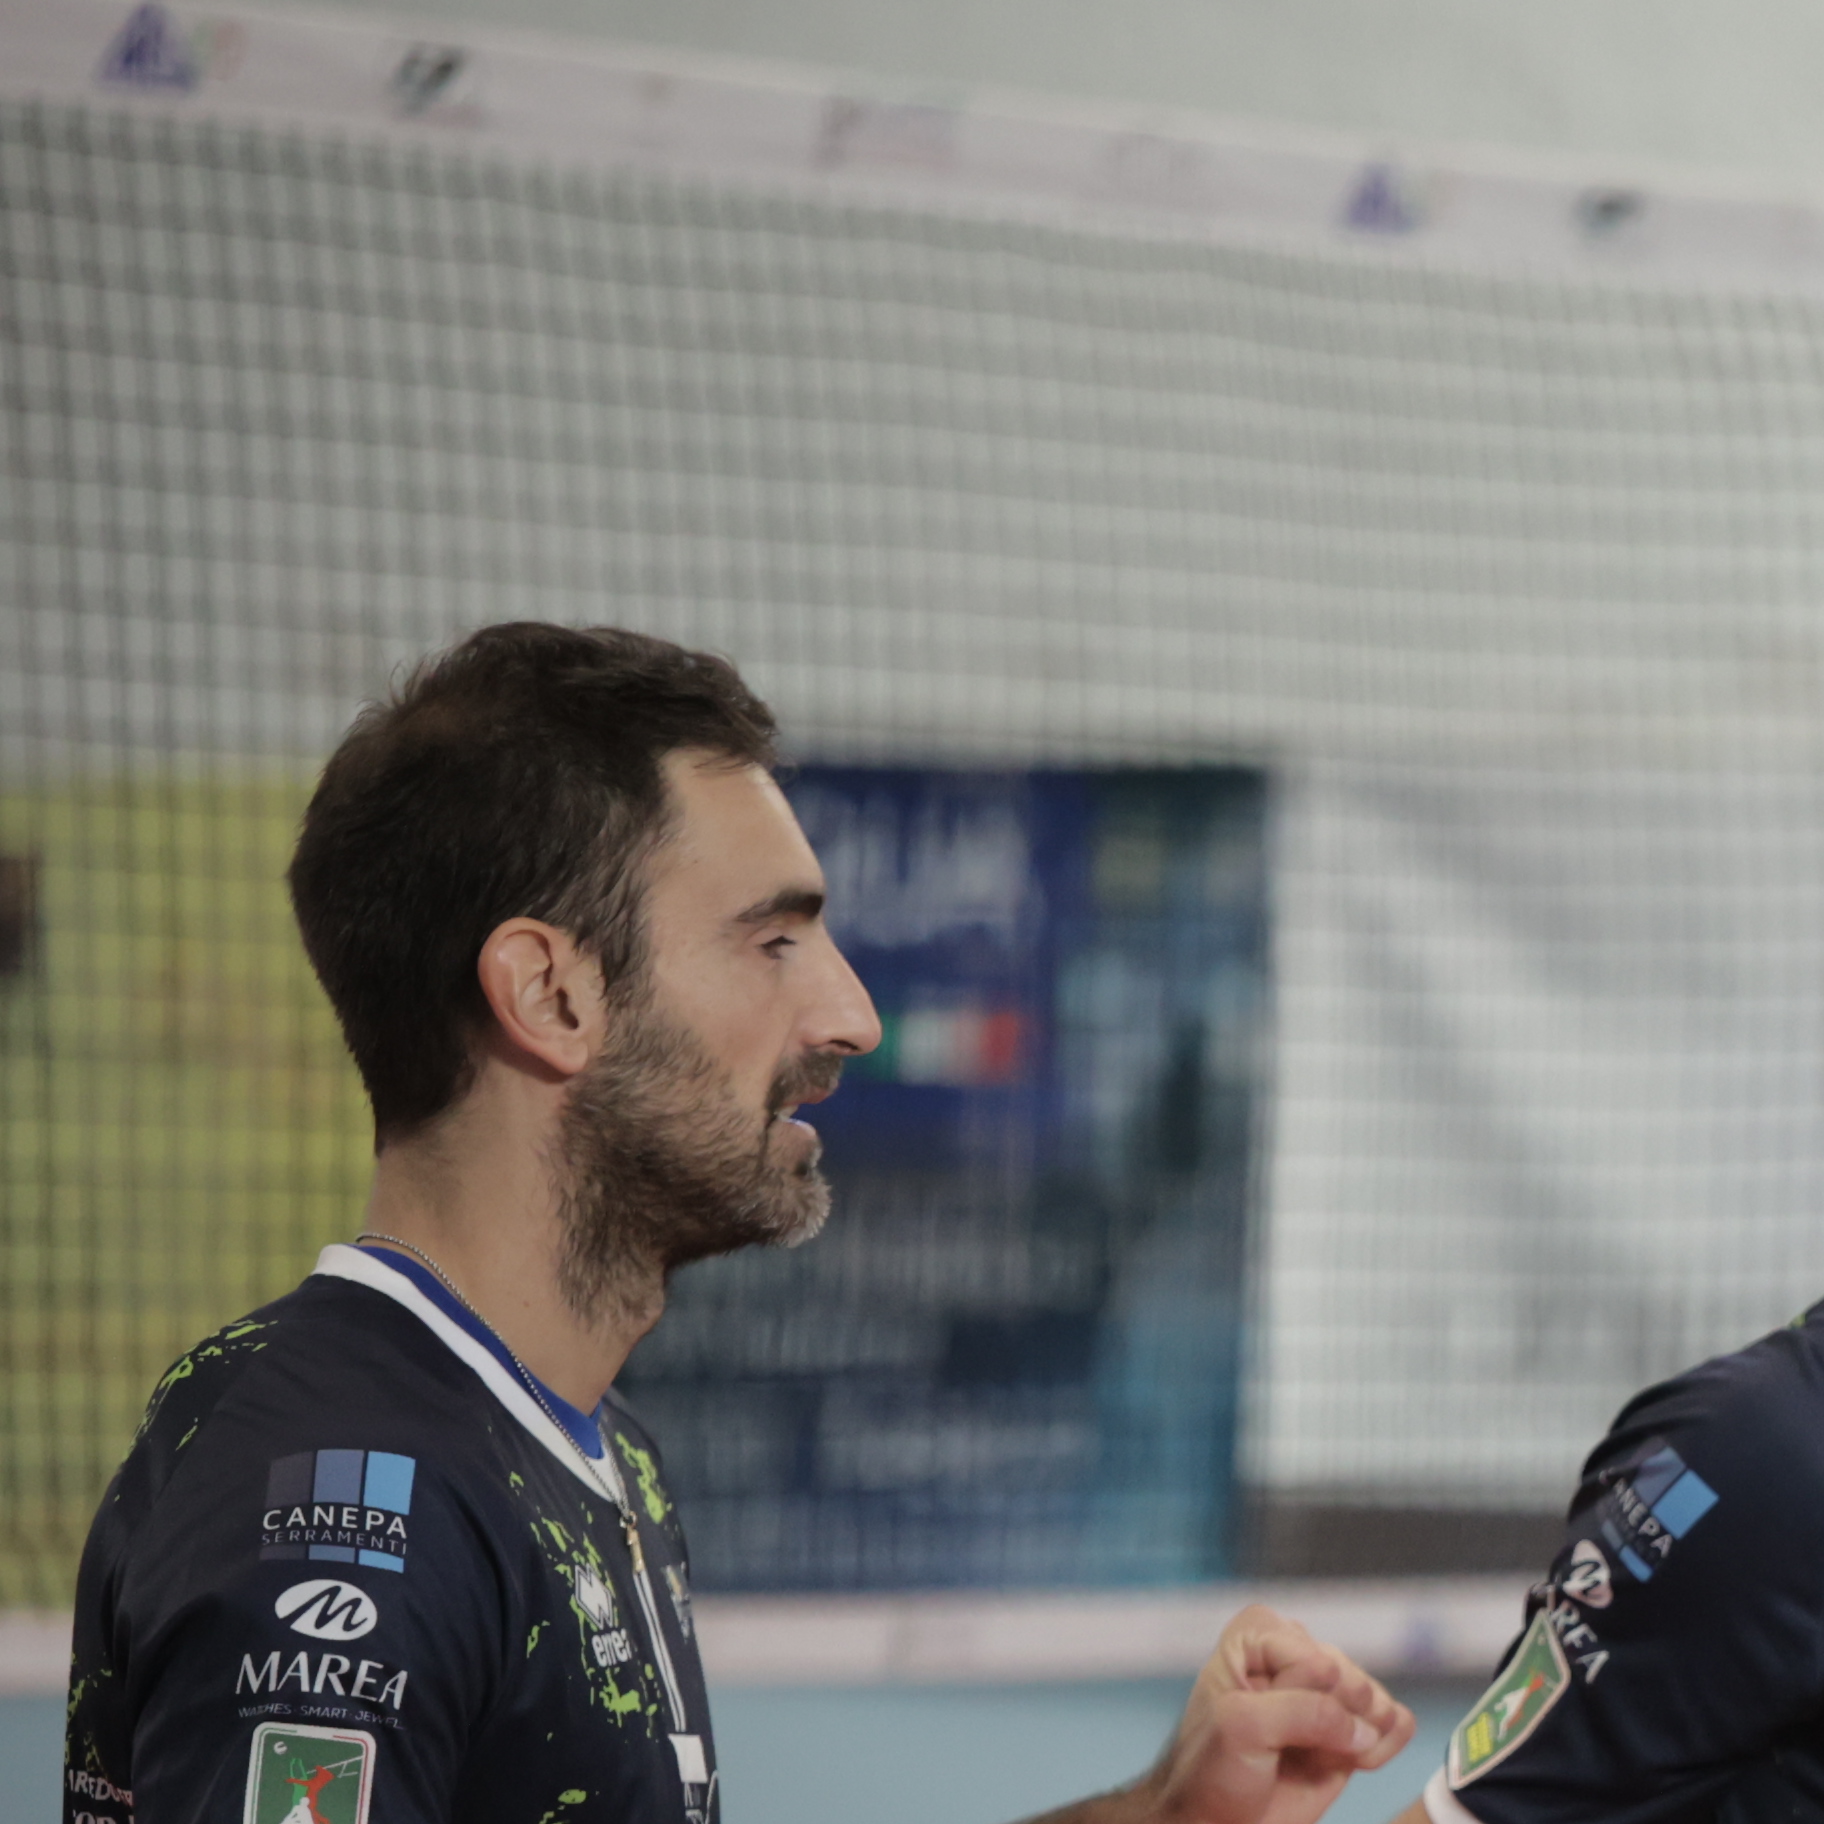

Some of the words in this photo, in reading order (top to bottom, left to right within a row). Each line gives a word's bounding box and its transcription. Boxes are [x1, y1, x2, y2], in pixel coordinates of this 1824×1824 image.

[262, 1505, 408, 1540] CANEPA
[261, 1529, 407, 1555] SERRAMENTI
[235, 1651, 408, 1711] MAREA
[300, 1704, 348, 1720] SMART
